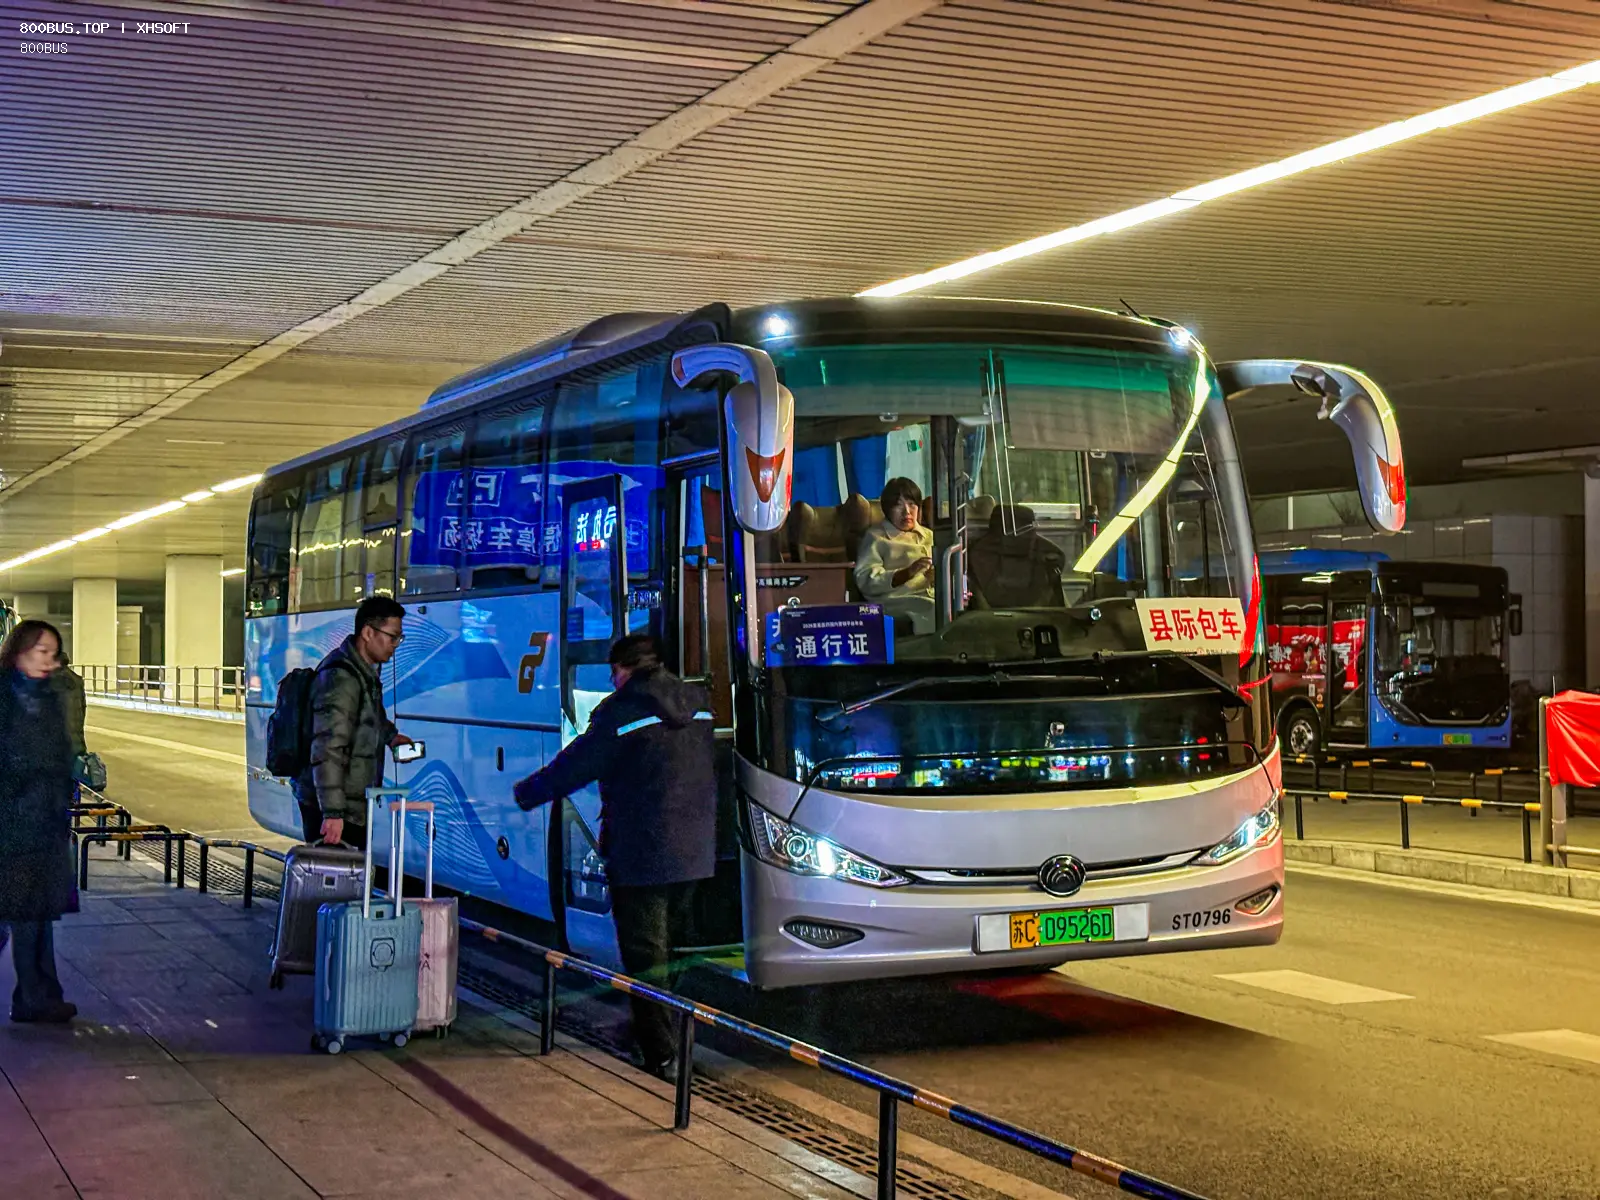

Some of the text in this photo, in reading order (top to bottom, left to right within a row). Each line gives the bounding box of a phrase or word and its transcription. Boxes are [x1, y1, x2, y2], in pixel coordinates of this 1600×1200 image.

[1149, 608, 1241, 642] 县际包车
[795, 633, 869, 658] 通行证
[1172, 908, 1231, 931] ST0796
